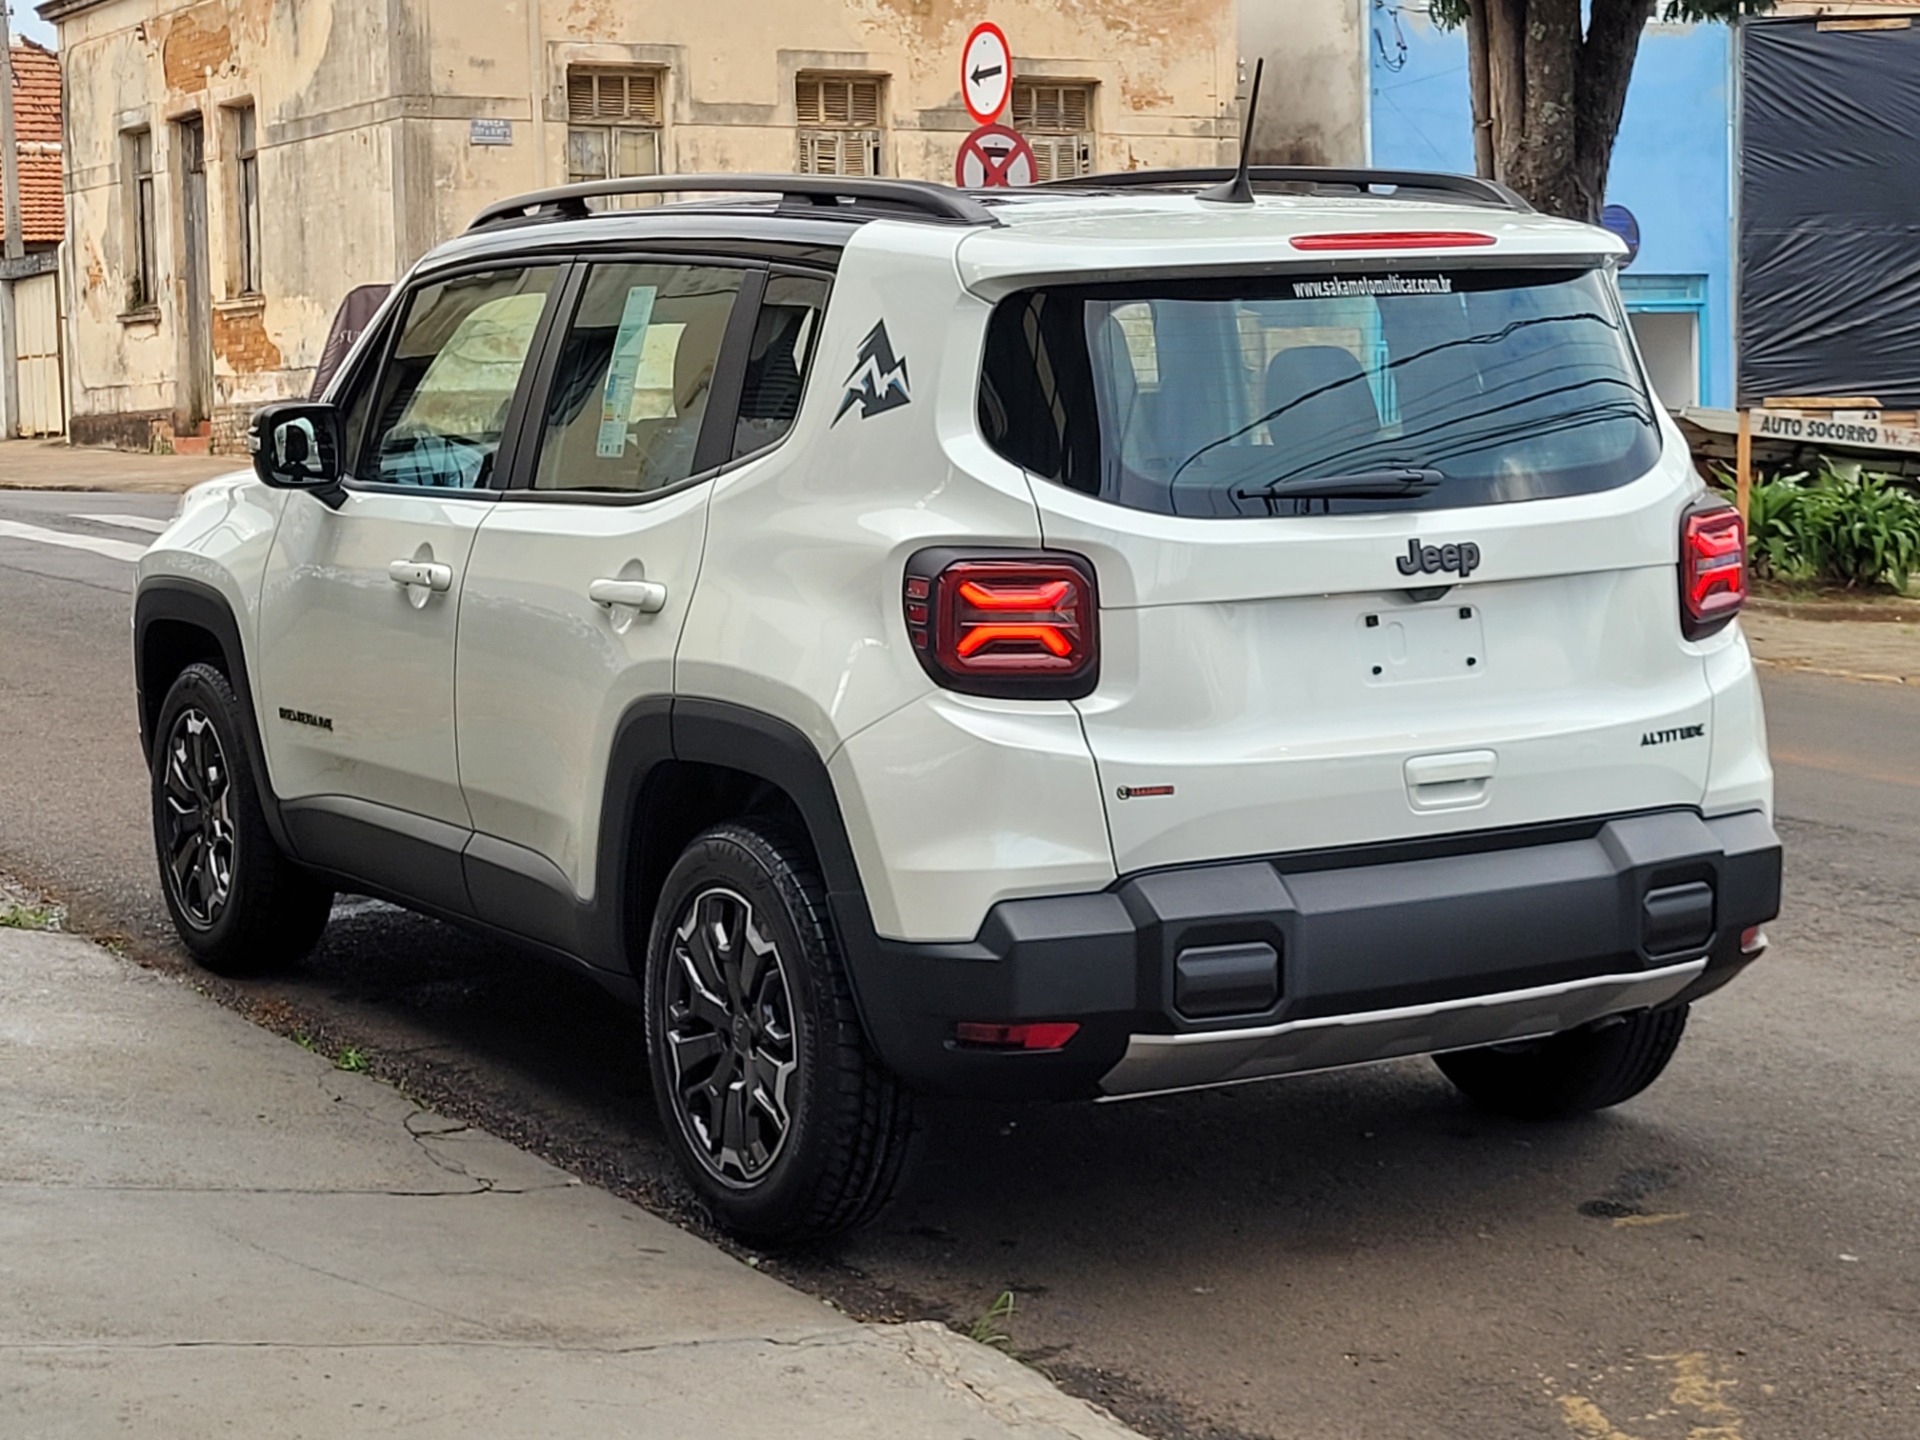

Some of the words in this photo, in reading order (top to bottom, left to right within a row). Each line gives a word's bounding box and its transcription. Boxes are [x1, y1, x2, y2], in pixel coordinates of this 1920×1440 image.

[1760, 416, 1802, 436] AUTO
[1807, 421, 1878, 443] SOCORRO
[1396, 538, 1480, 577] Jeep
